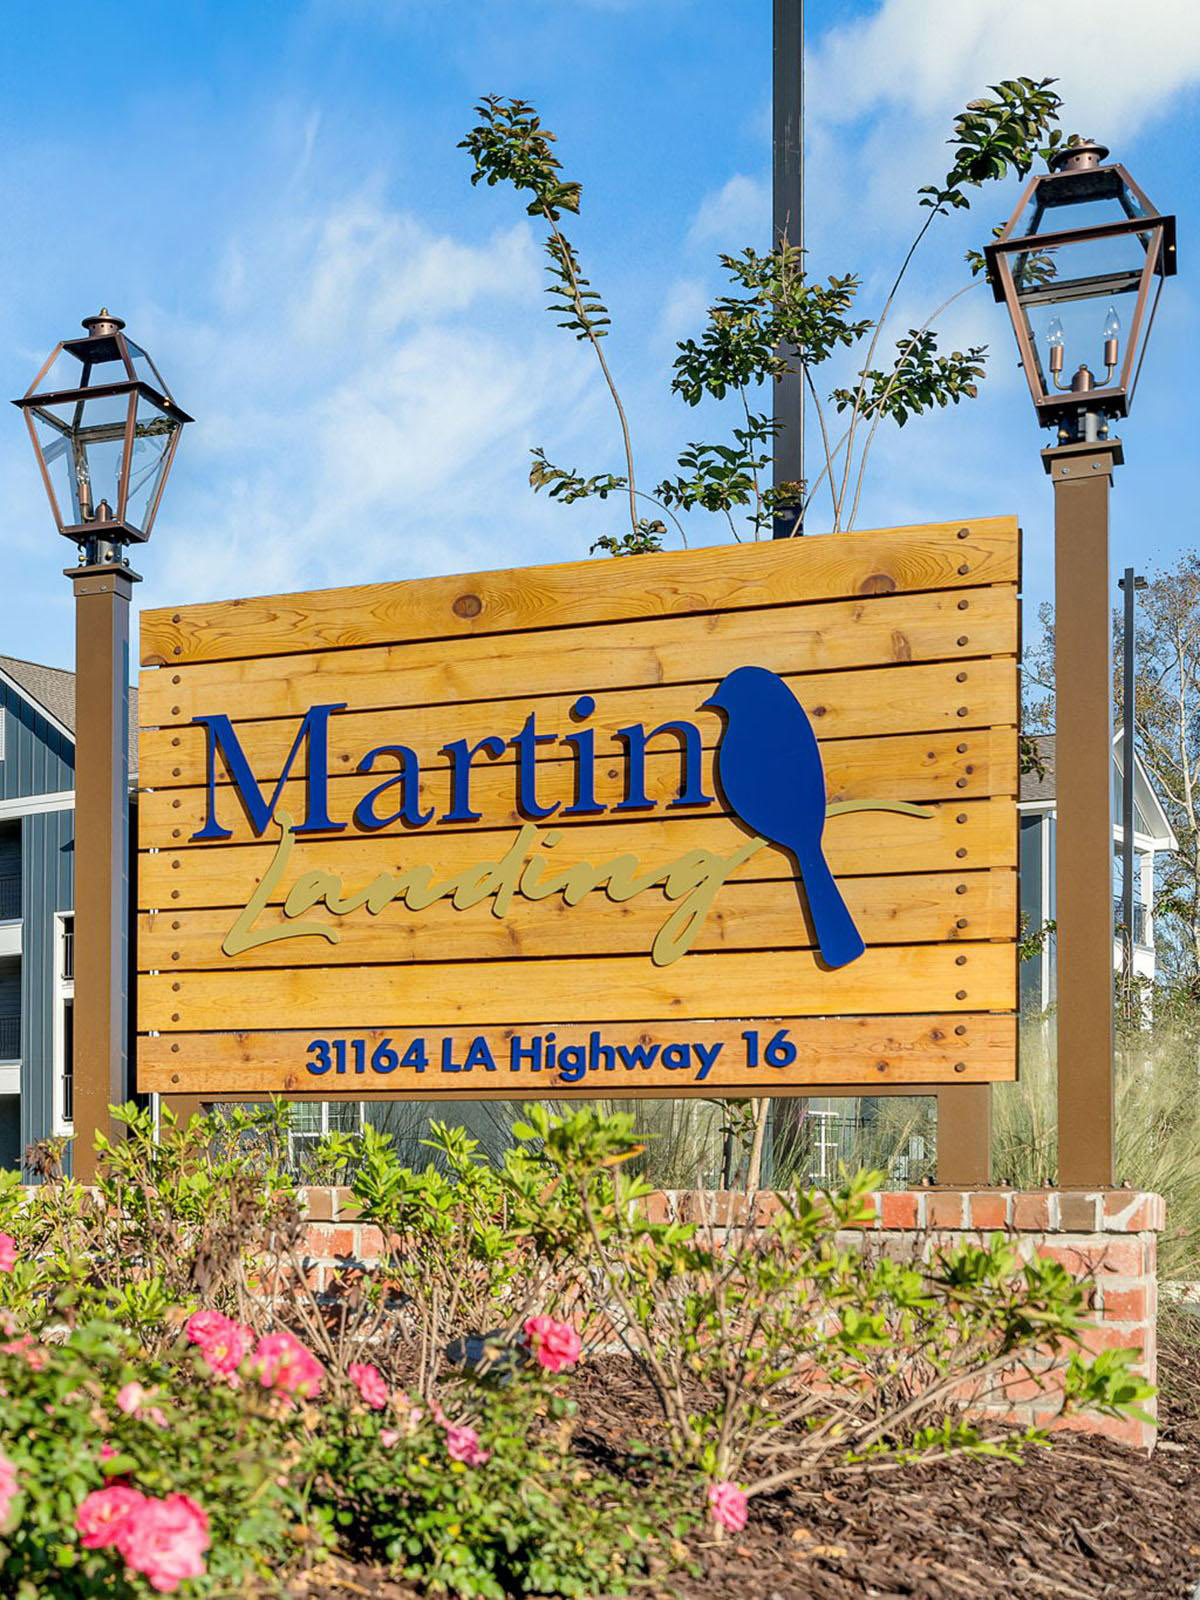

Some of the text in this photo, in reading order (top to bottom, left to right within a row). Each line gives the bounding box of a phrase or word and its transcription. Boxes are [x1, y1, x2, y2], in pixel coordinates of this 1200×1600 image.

[190, 695, 715, 841] Martin
[222, 812, 768, 966] Landing
[306, 1029, 798, 1081] 31164 LA Highway 16
